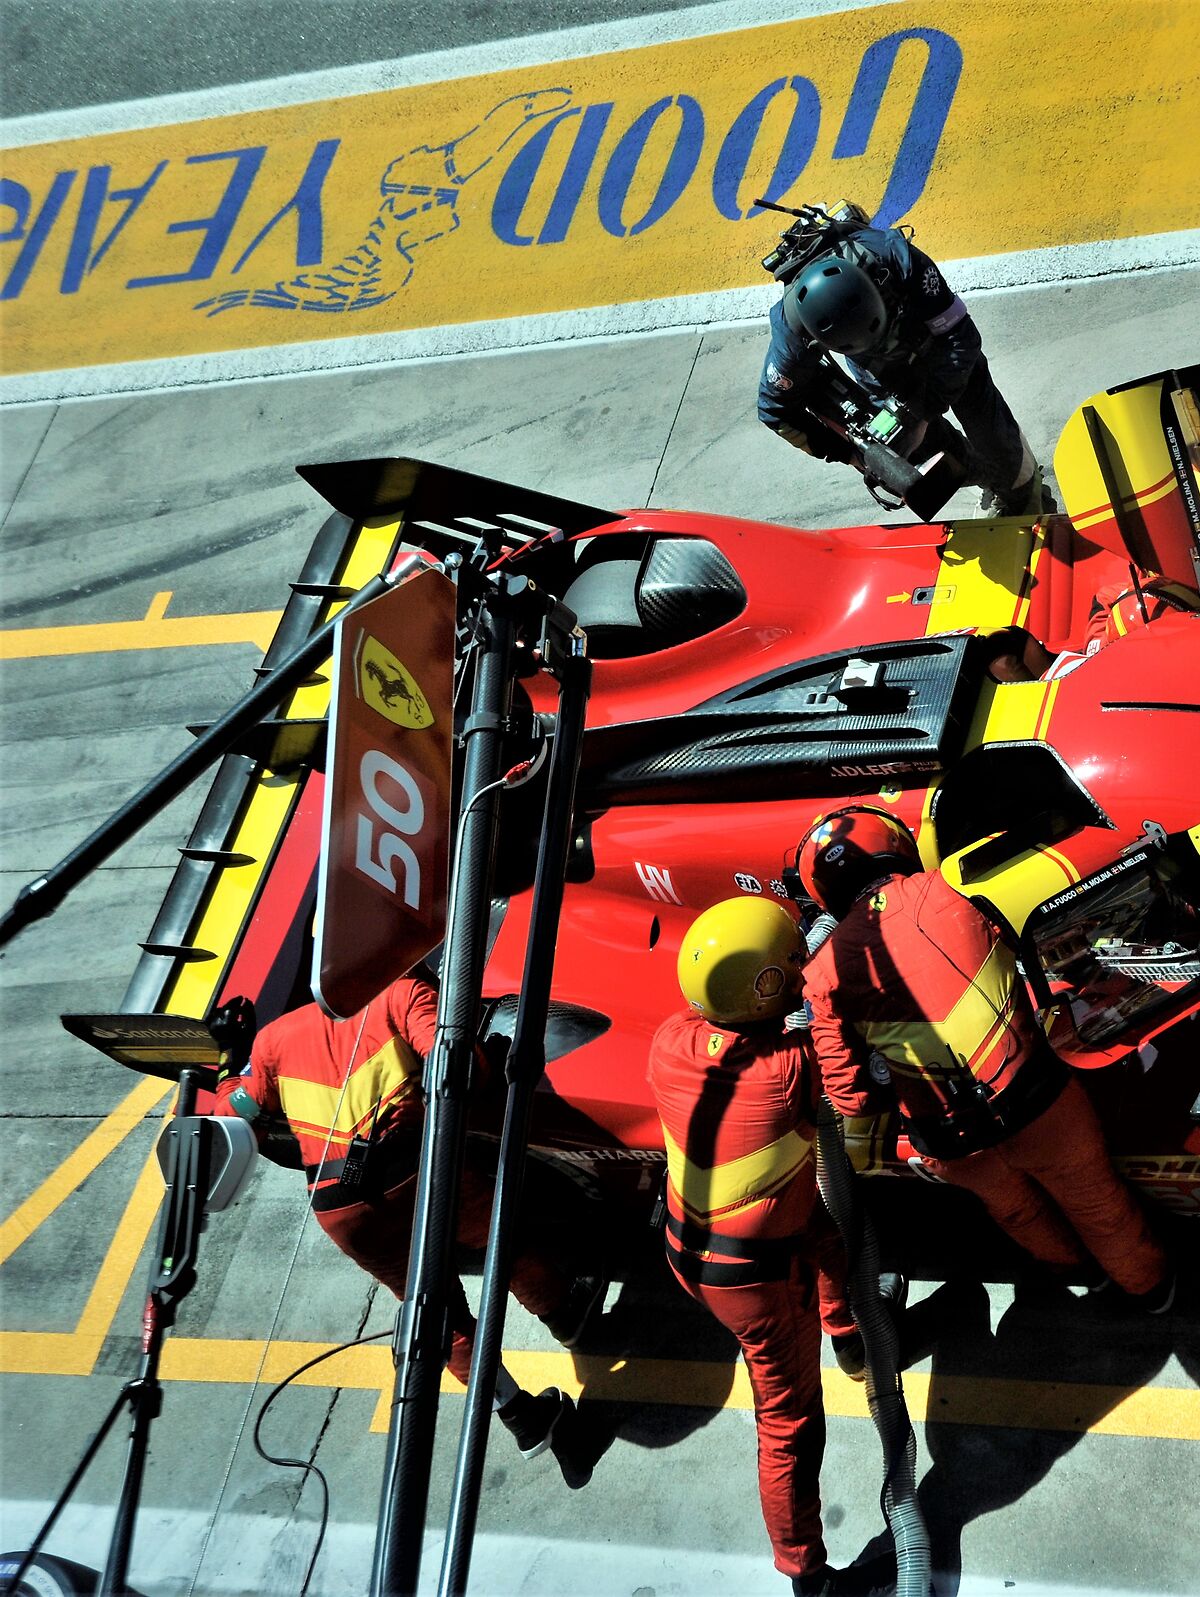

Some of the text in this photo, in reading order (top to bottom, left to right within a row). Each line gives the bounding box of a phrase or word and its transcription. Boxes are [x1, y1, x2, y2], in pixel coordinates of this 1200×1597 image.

[490, 27, 963, 247] GOOD
[831, 764, 898, 777] ADLER
[355, 749, 425, 912] 50
[826, 847, 842, 860] BELL
[634, 862, 683, 905] HY
[735, 875, 761, 892] FIA
[116, 1027, 212, 1039] Santande
